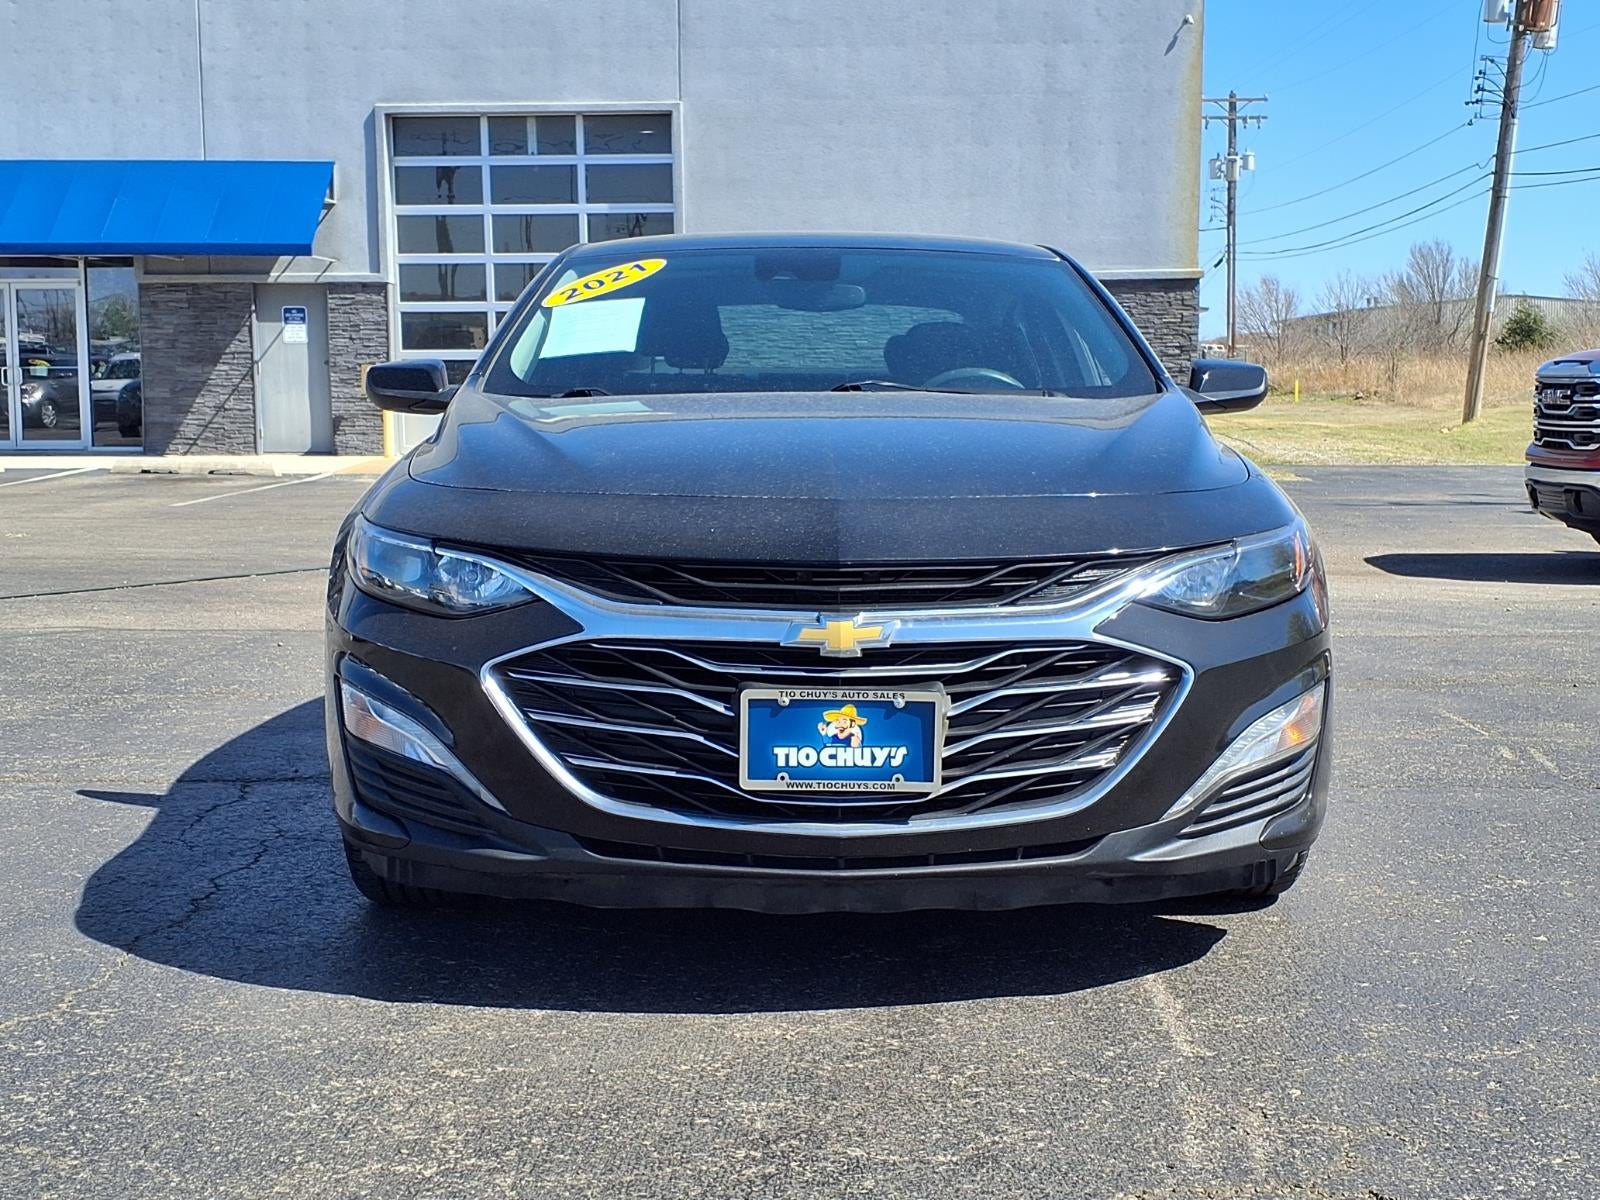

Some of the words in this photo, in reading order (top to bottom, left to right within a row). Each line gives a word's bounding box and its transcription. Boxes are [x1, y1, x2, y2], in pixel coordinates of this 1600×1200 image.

[560, 263, 648, 301] 2021
[1541, 389, 1571, 405] GMC
[778, 690, 796, 698] TIO
[799, 690, 838, 699] CHUY'S
[841, 691, 870, 699] AUTO
[872, 692, 906, 700] SALES
[785, 781, 896, 791] WWW.TIOCHUYS.COM
